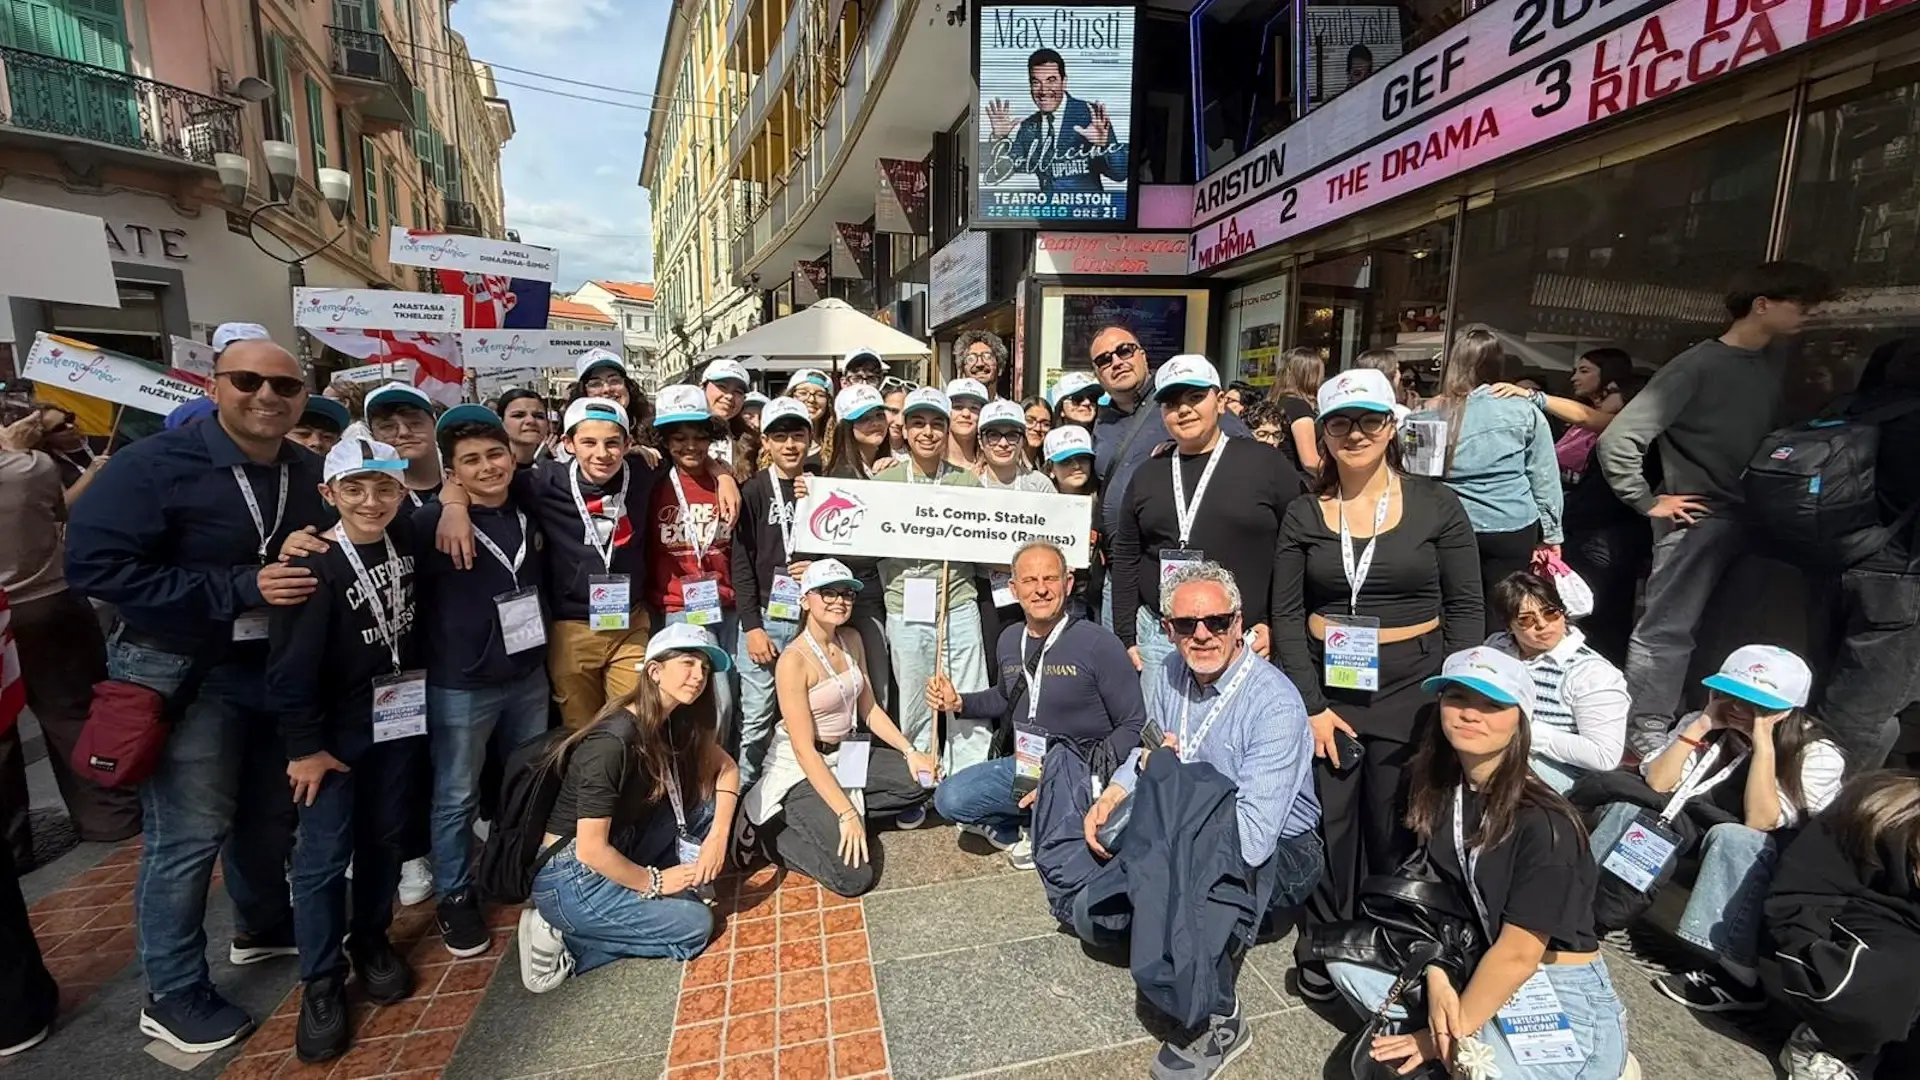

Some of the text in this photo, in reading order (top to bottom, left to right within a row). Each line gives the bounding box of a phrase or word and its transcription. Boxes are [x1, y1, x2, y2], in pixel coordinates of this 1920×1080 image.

[993, 8, 1121, 49] Max Giusti
[1593, 15, 1668, 80] LA
[1588, 11, 1782, 122] RICCA
[1382, 35, 1470, 121] GEF
[1531, 59, 1572, 118] 3
[1326, 106, 1500, 204] THE DRAMA
[1052, 158, 1090, 178] UPDATE
[1194, 142, 1287, 218] ARISTON
[993, 192, 1112, 205] TEATRO ARISTON
[1280, 187, 1298, 224] 2
[988, 205, 1117, 218] 22 MAGGIO ORE 21
[1218, 216, 1239, 243] LA
[502, 249, 529, 259] AMELI
[1190, 234, 1198, 261] 1
[1199, 229, 1256, 268] MUMMIA
[392, 302, 445, 312] ANASTASIA
[394, 312, 445, 321] TKHELIDZE
[139, 385, 190, 404] RUŽEVS
[156, 378, 206, 396] AMELIJA
[915, 505, 1046, 526] Ist. Comp. Statale
[880, 522, 896, 533] G.
[900, 522, 1008, 541] Verga/Comiso
[1506, 1013, 1561, 1025] PARTECIPANTE
[1513, 1021, 1559, 1033] PARTICIPANT
